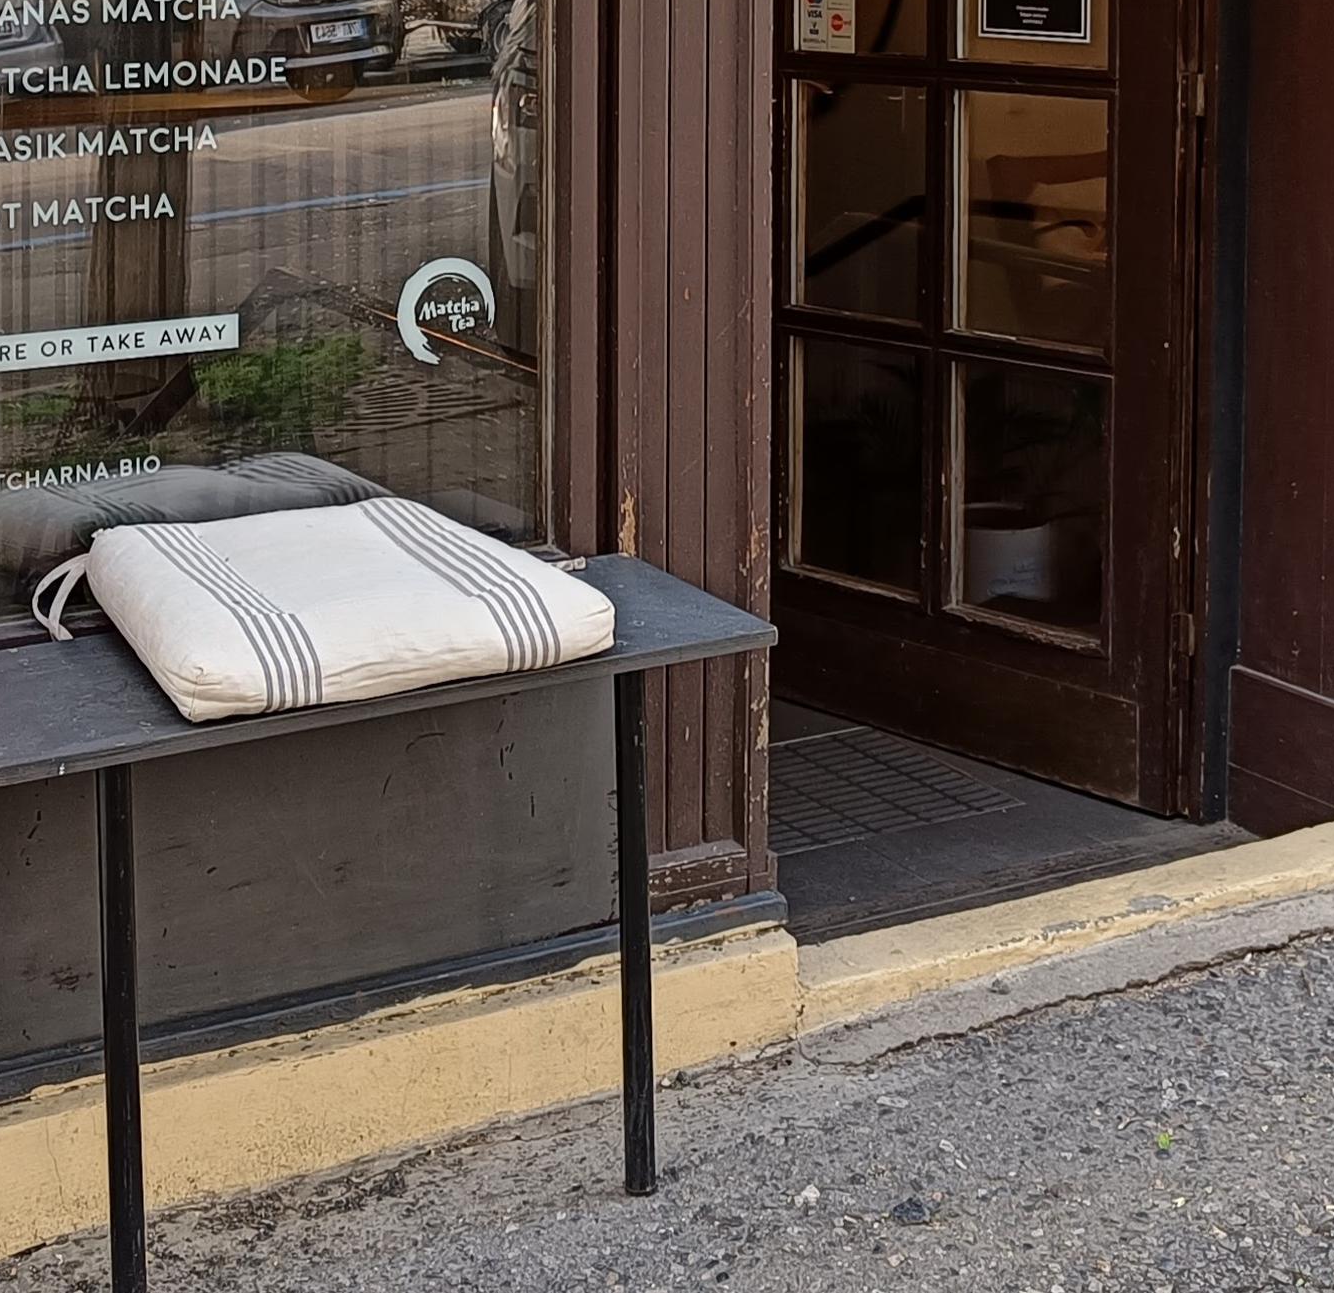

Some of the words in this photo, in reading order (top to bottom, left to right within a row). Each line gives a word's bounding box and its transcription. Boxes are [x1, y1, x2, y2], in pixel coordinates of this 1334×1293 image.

[105, 57, 287, 91] LEMONADE
[78, 125, 218, 158] MATCHA
[32, 193, 175, 226] MATCHA
[419, 296, 480, 321] Matcha
[448, 314, 475, 333] Tea
[41, 337, 73, 358] OR
[87, 330, 146, 353] TAKE
[159, 324, 228, 346] AWAY
